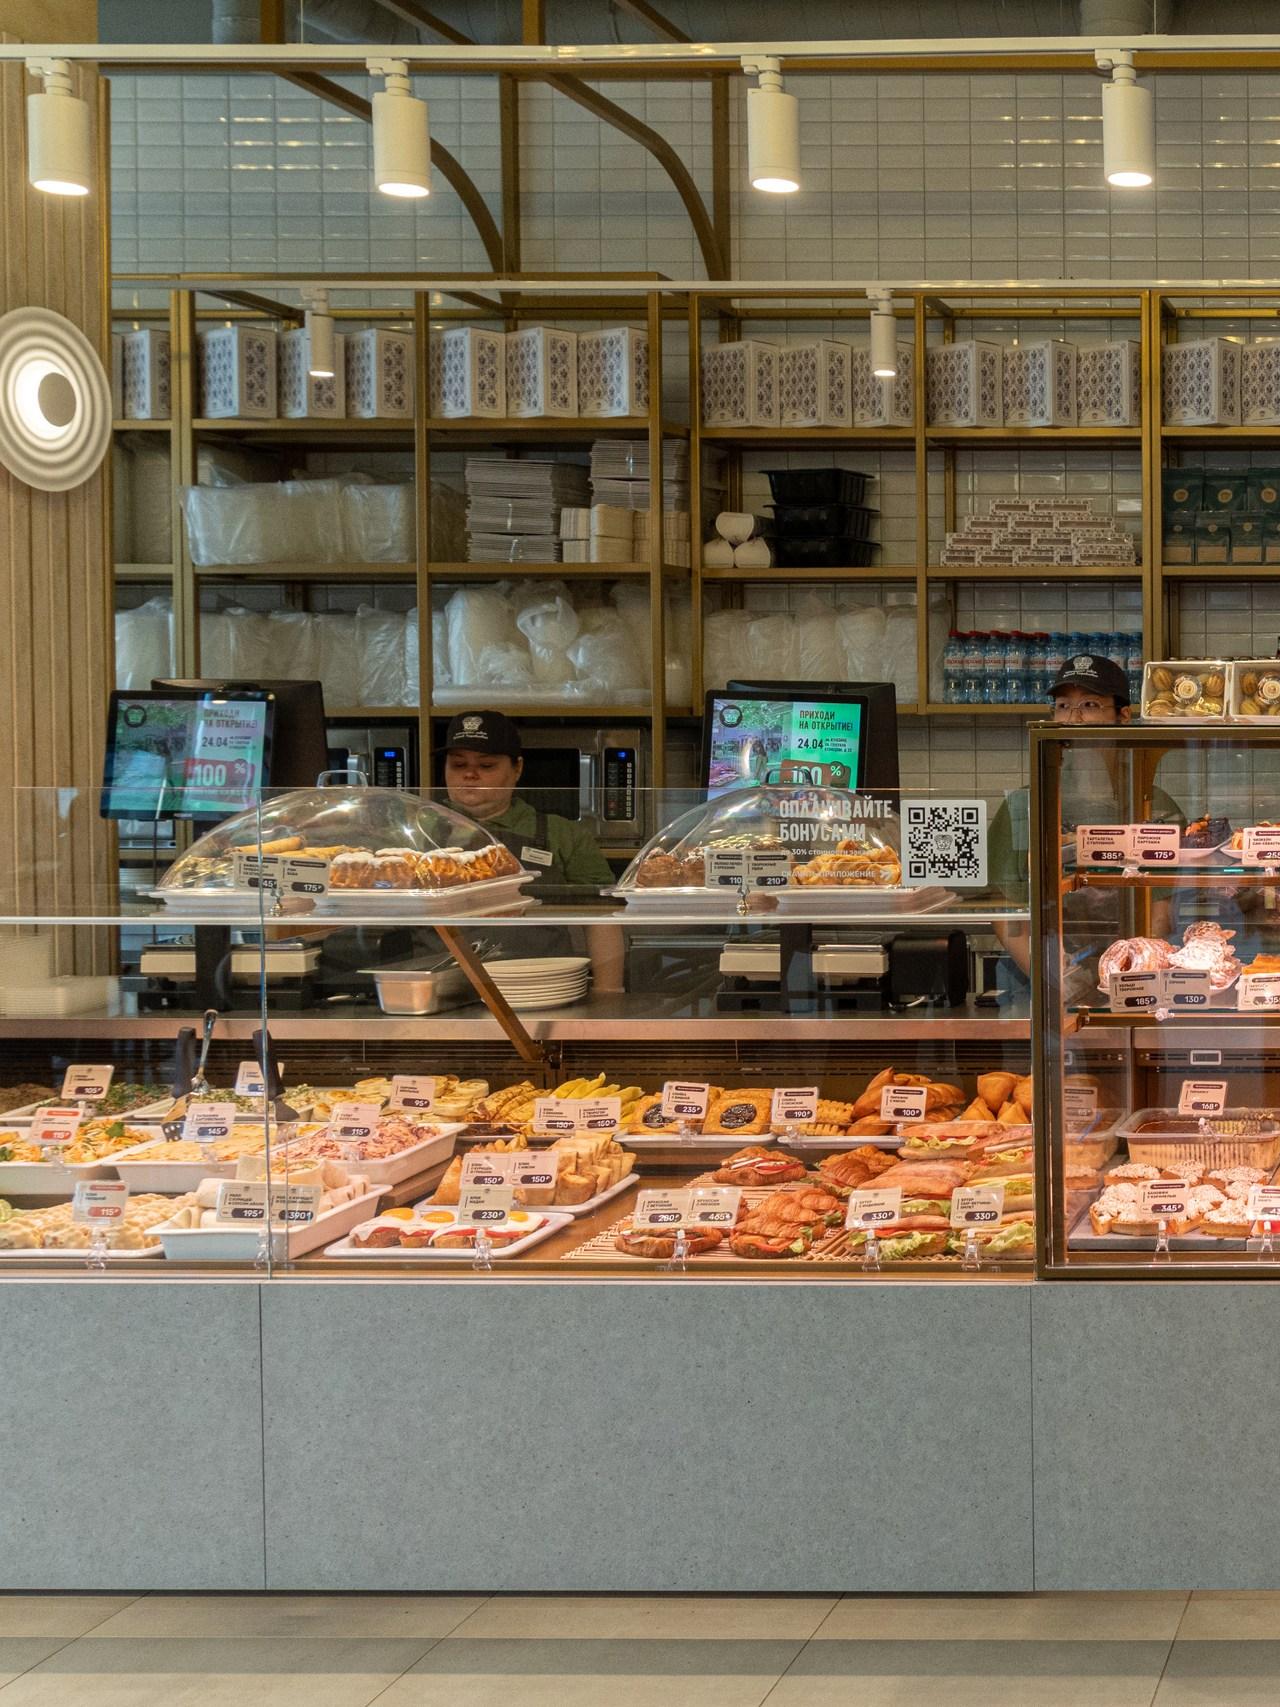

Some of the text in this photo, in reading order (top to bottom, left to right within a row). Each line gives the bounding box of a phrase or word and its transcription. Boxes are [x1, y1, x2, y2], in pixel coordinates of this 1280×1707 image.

[800, 710, 836, 720] ПРИХОДИ
[799, 721, 853, 732] НА ОТКРЫТИЕ!
[201, 736, 228, 748] 24.04
[797, 738, 824, 749] 24.04
[830, 765, 842, 777] %
[780, 795, 893, 818] ОПЛАЧИВАЙТЕ
[780, 823, 866, 842] БОНУСАМИ
[821, 870, 877, 878] ПРИЛОЖЕНИЕ
